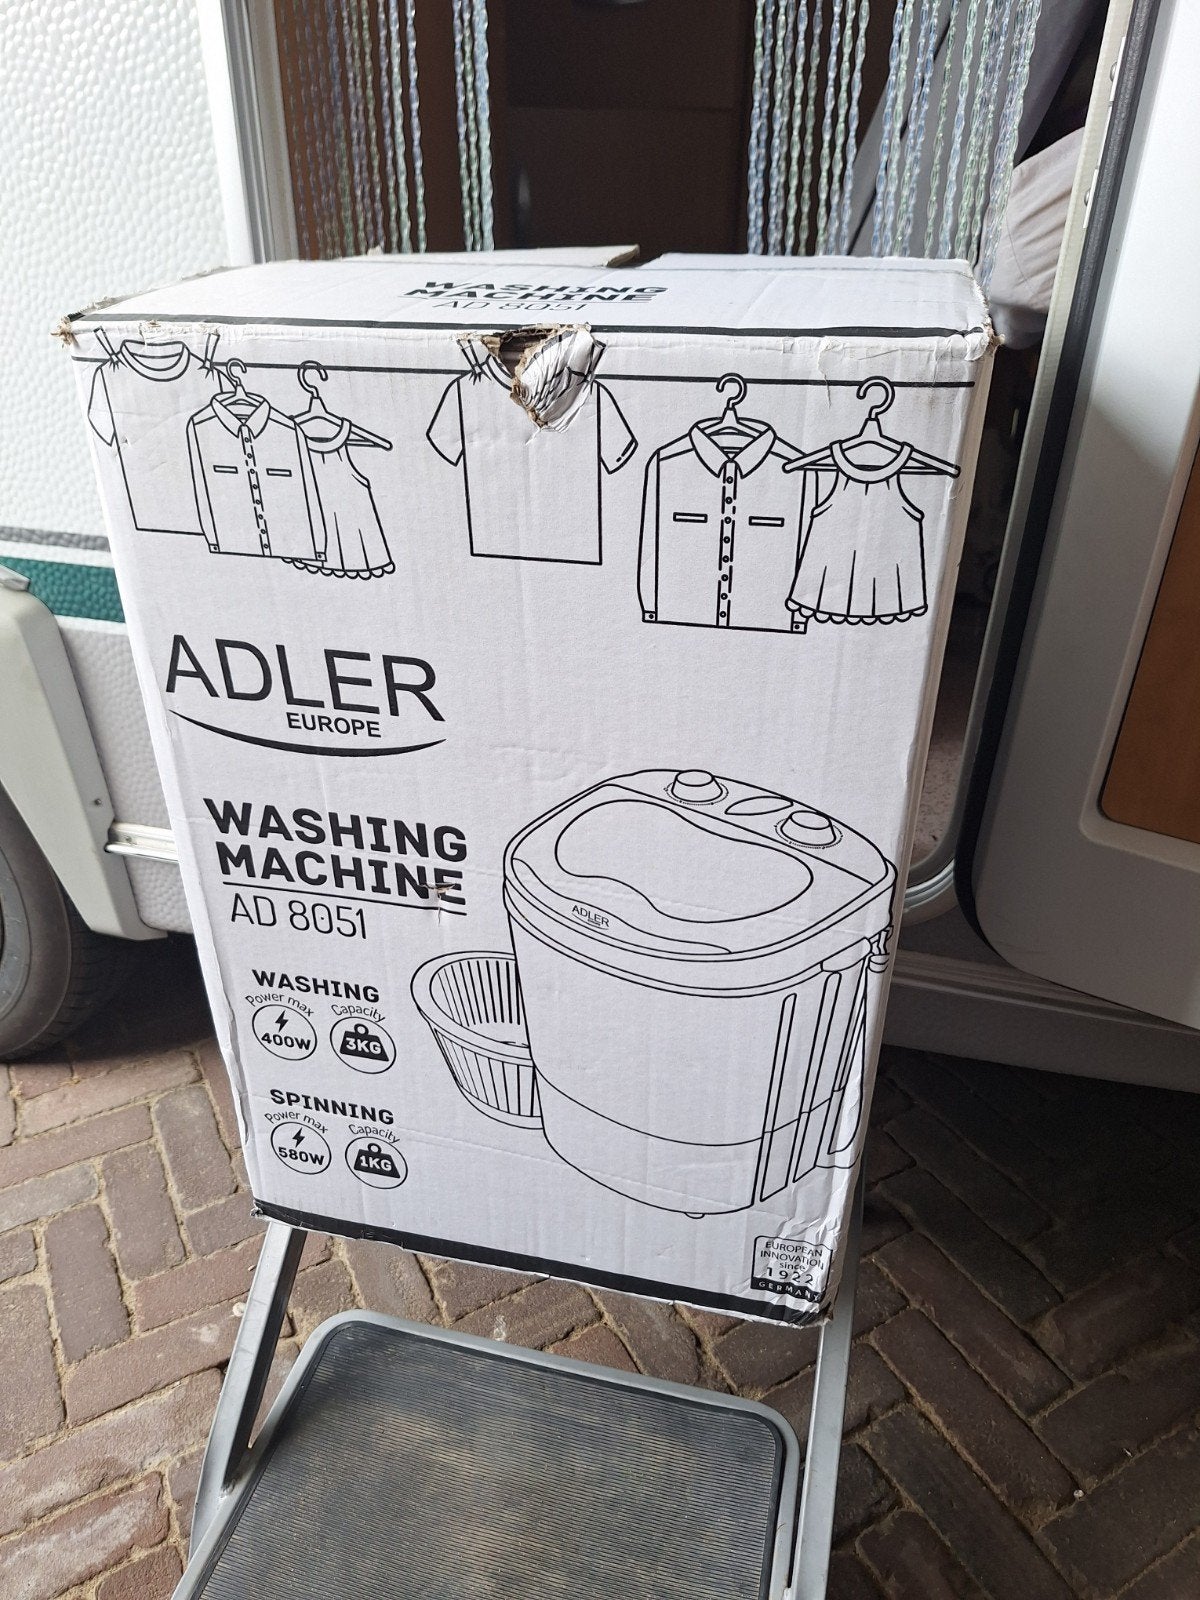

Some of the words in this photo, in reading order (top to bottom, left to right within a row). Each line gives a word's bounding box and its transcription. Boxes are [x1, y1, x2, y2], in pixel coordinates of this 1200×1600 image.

[404, 288, 654, 301] MACHINE
[425, 281, 669, 294] WASHING
[433, 300, 490, 309] AD
[499, 303, 588, 311] 8051
[166, 634, 446, 722] ADLER
[286, 711, 382, 738] EUROPE
[202, 797, 468, 863] WASHING
[215, 841, 467, 906] MACHINE
[230, 892, 278, 927] AD
[289, 899, 367, 940] 8051
[572, 905, 610, 927] ADLER
[252, 969, 380, 1003] WASHING
[245, 992, 285, 1007] Power
[287, 997, 314, 1017] max
[331, 1004, 386, 1022] Capacity
[261, 1032, 311, 1051] 400W
[345, 1037, 382, 1055] 3KG
[270, 1089, 394, 1125] SPINNING
[264, 1111, 301, 1124] Power
[303, 1115, 328, 1134] max
[348, 1124, 400, 1143] Capacity
[278, 1147, 325, 1166] 580W
[360, 1156, 393, 1172] 1KG
[765, 1241, 823, 1257] EUROPEAN
[760, 1250, 824, 1270] INNOVATION
[780, 1262, 806, 1270] since
[766, 1267, 814, 1286] 1922
[758, 1281, 820, 1301] GERMANY
